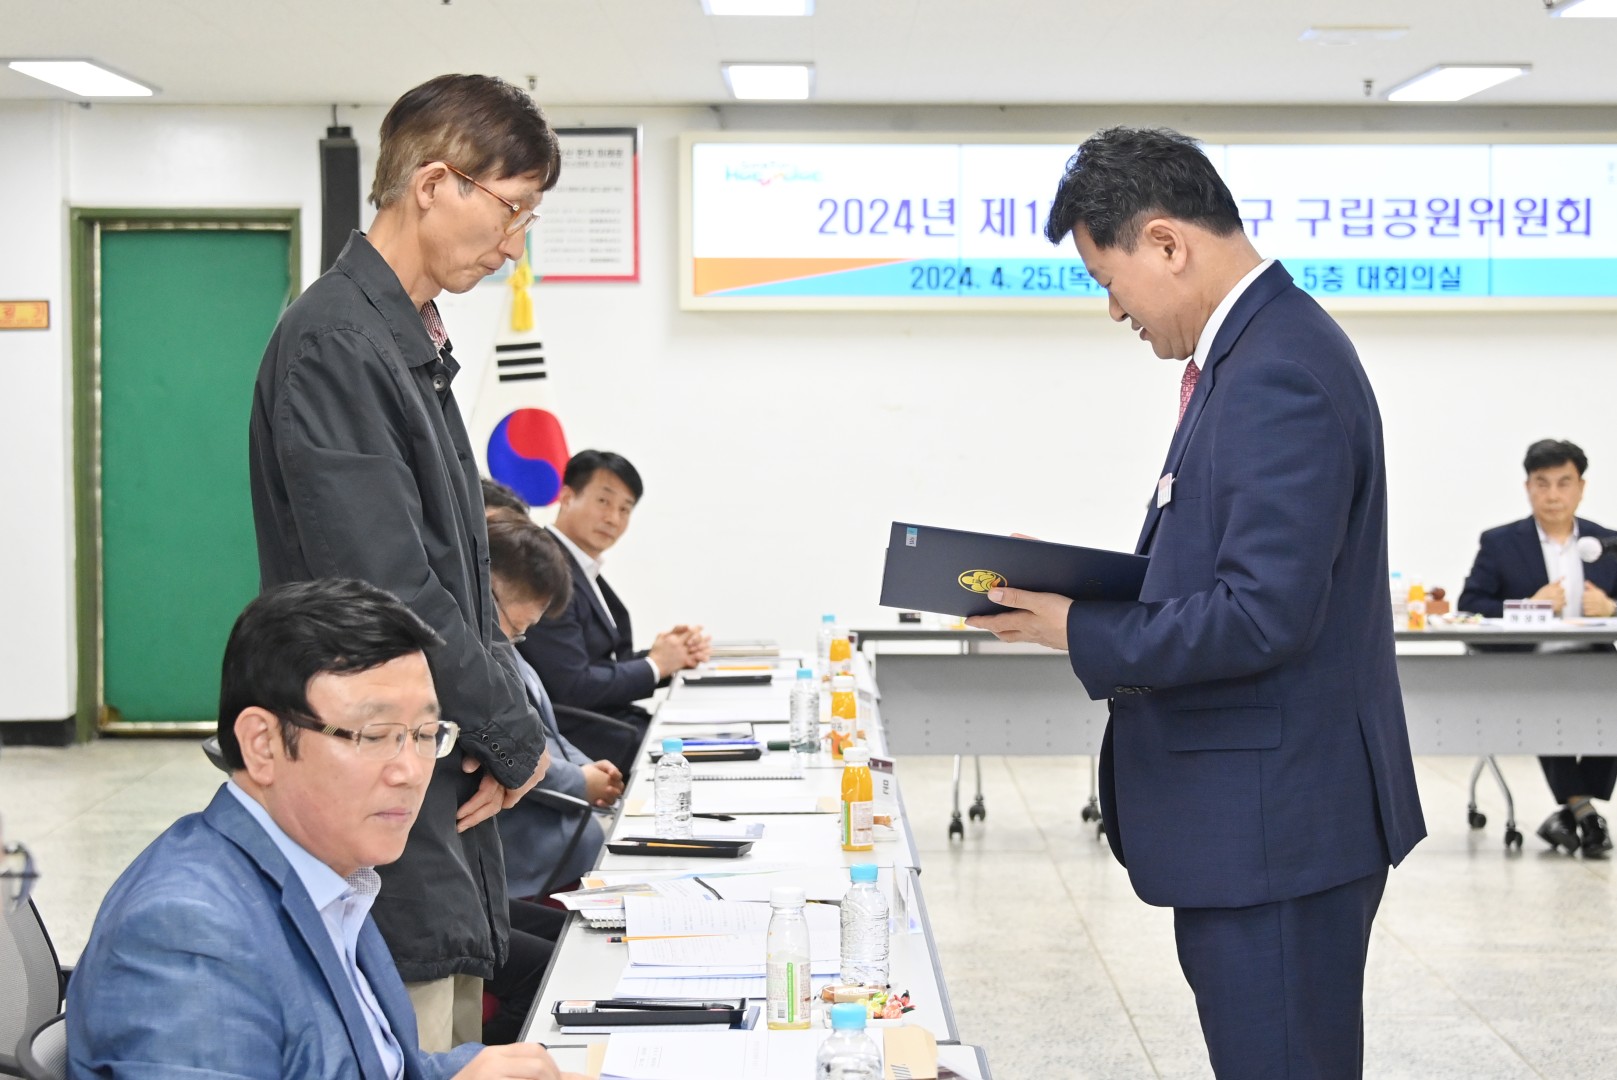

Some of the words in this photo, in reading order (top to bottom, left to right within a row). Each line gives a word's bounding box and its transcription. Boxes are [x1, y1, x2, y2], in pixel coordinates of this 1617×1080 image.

[817, 197, 956, 239] 2024년
[979, 197, 1054, 238] 제1
[1297, 197, 1593, 240] 구립공원위원회
[910, 265, 980, 291] 2024.
[991, 265, 1012, 290] 4.
[1302, 265, 1344, 291] 5층
[1357, 265, 1463, 292] 대회의실
